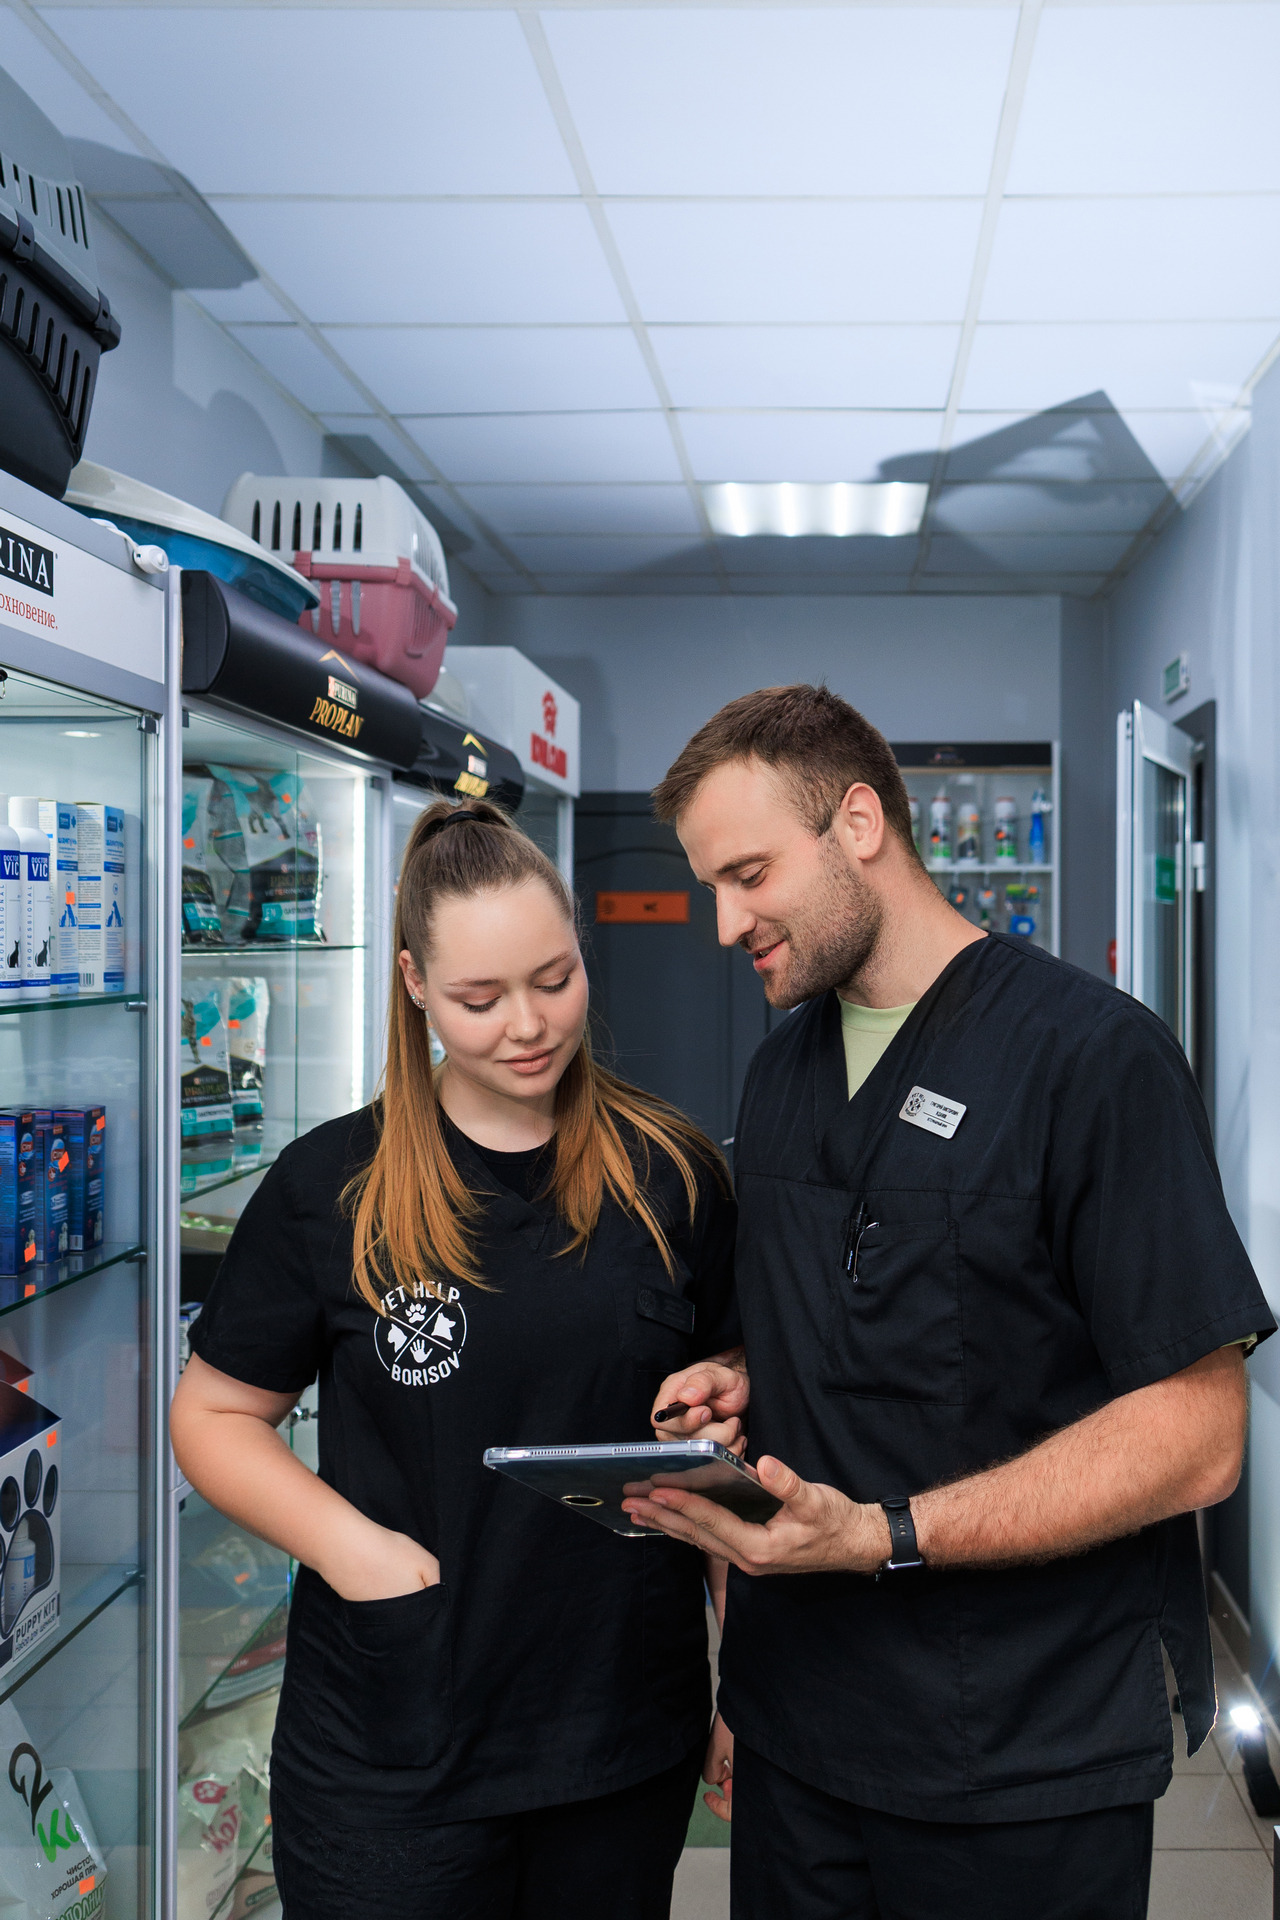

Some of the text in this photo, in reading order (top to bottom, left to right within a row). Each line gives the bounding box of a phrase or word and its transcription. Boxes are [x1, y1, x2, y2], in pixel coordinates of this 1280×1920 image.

[4, 861, 19, 876] VIC
[32, 863, 48, 877] VIC
[412, 1281, 460, 1303] HELP
[391, 1351, 460, 1387] BORISOV
[15, 1597, 56, 1643] PUPPY KIT
[51, 1871, 84, 1900] ХОРОШАЯ
